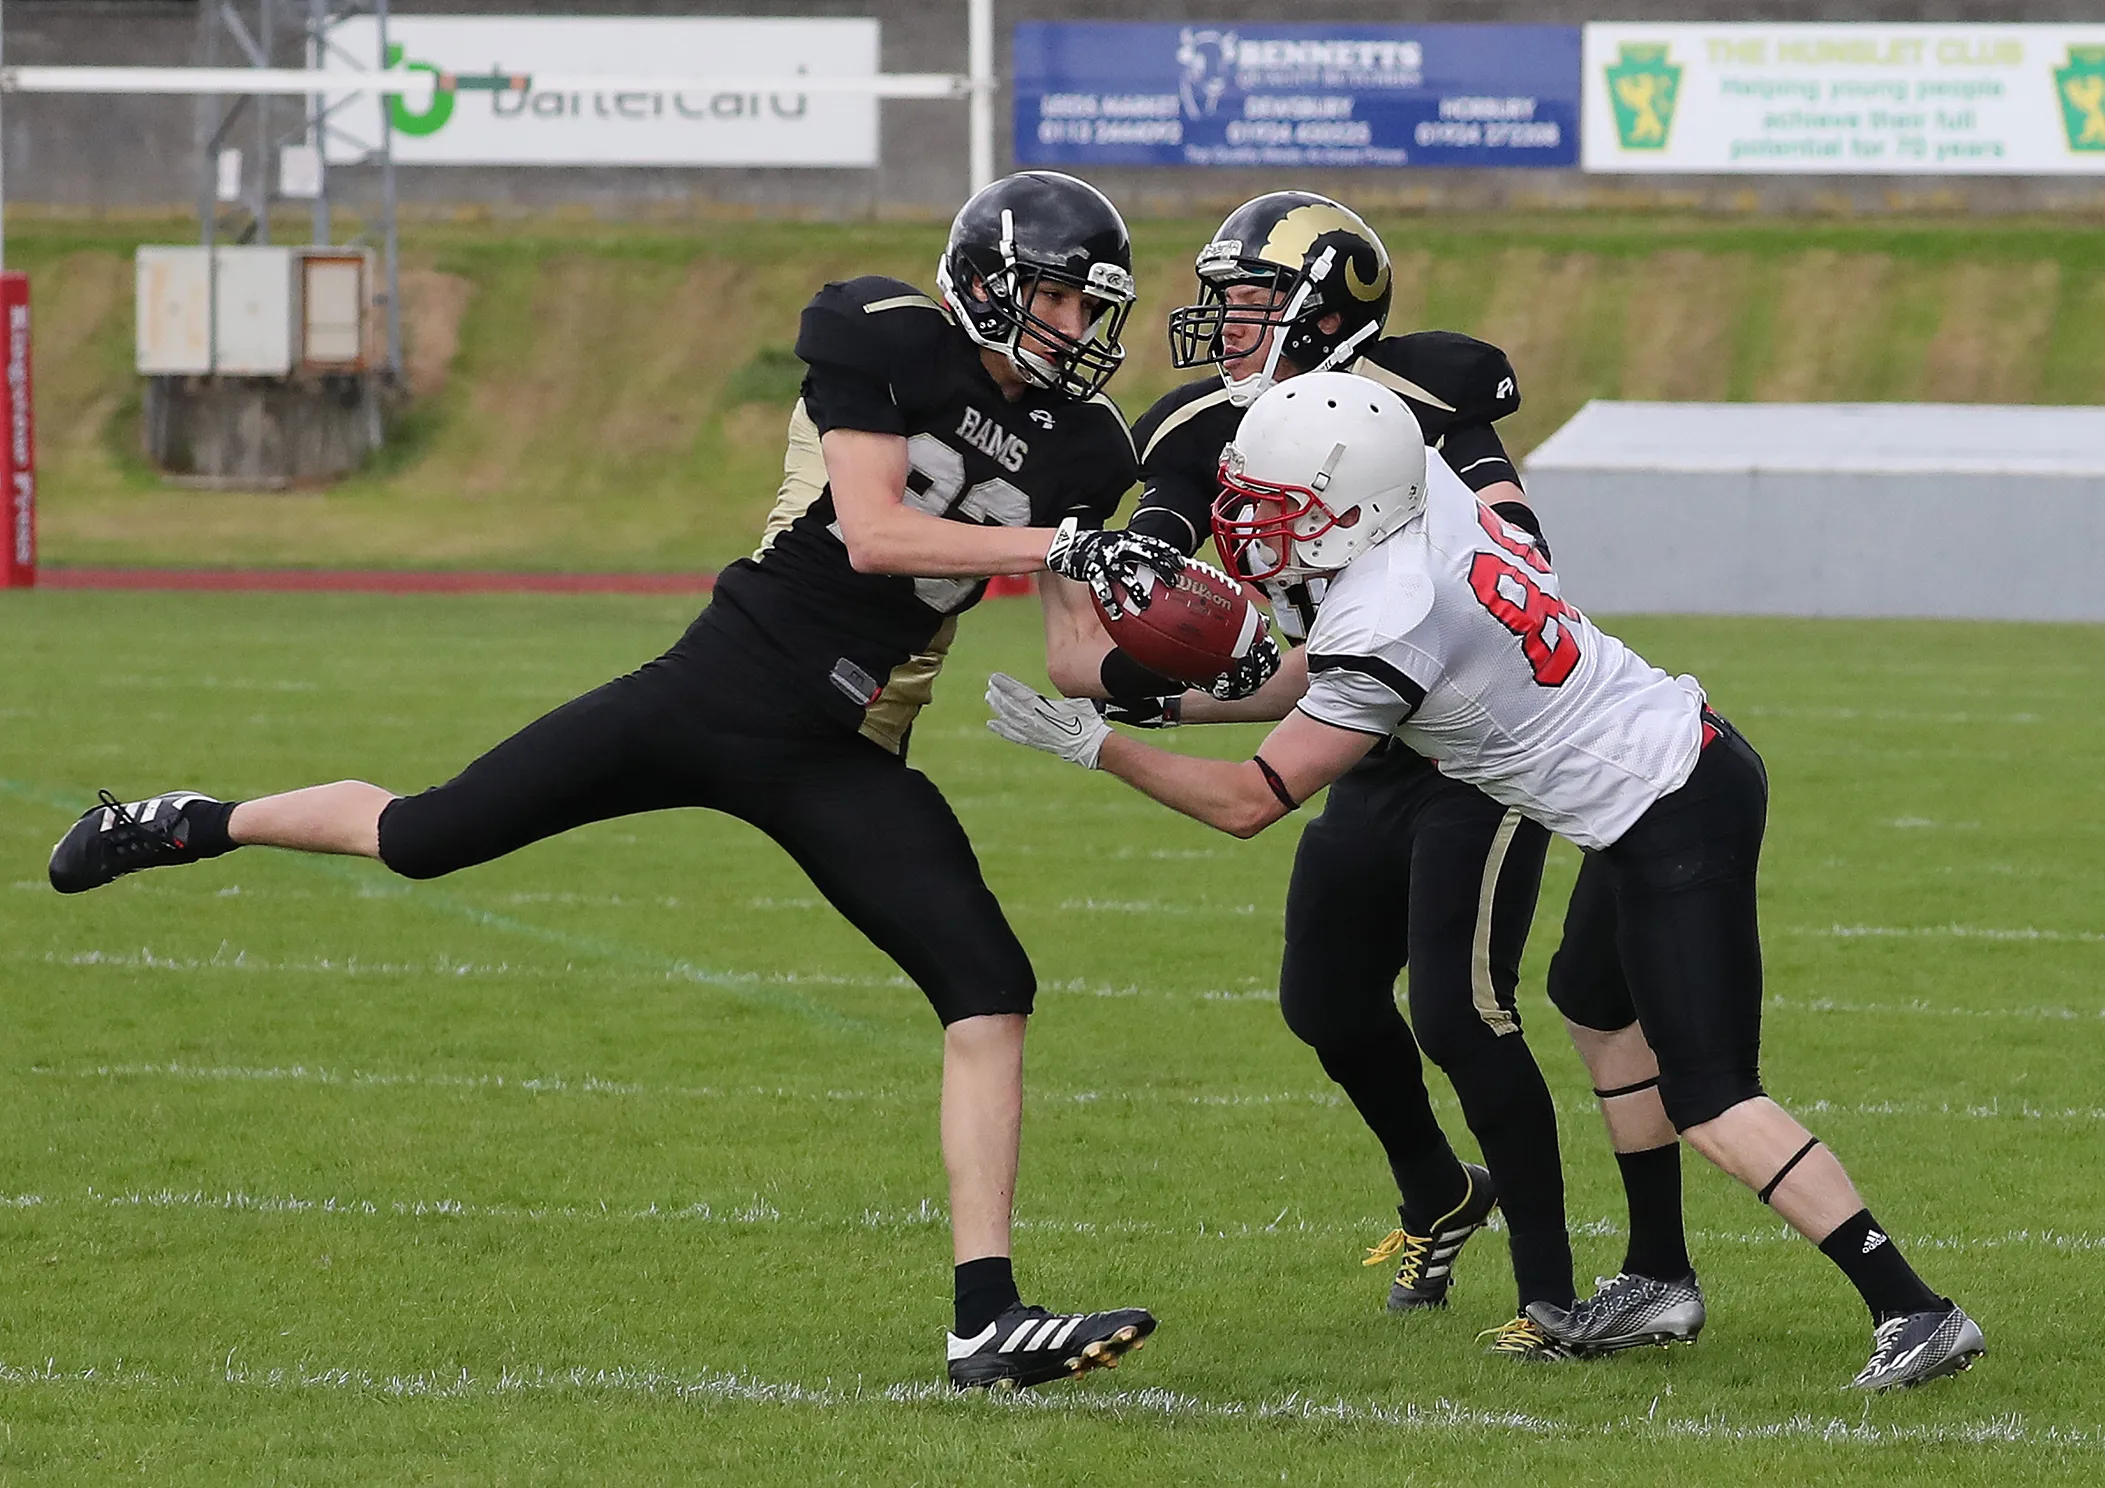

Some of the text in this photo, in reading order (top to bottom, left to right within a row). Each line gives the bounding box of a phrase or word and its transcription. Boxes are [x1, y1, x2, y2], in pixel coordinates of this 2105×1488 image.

[1238, 39, 1423, 71] BENNETTS
[1705, 38, 2024, 67] THE HUNSLET CLUB
[1720, 77, 2005, 101] Helping young people
[1100, 94, 1181, 119] MARKET
[1243, 95, 1355, 121] DEWSBURY
[1438, 96, 1538, 122] HORBURY
[1763, 110, 1977, 130] achieve their full
[1729, 138, 1843, 160] potential
[1850, 137, 1886, 158] for
[1935, 140, 2006, 161] years
[955, 405, 1029, 473] RAMS
[1174, 573, 1232, 611] Wilson
